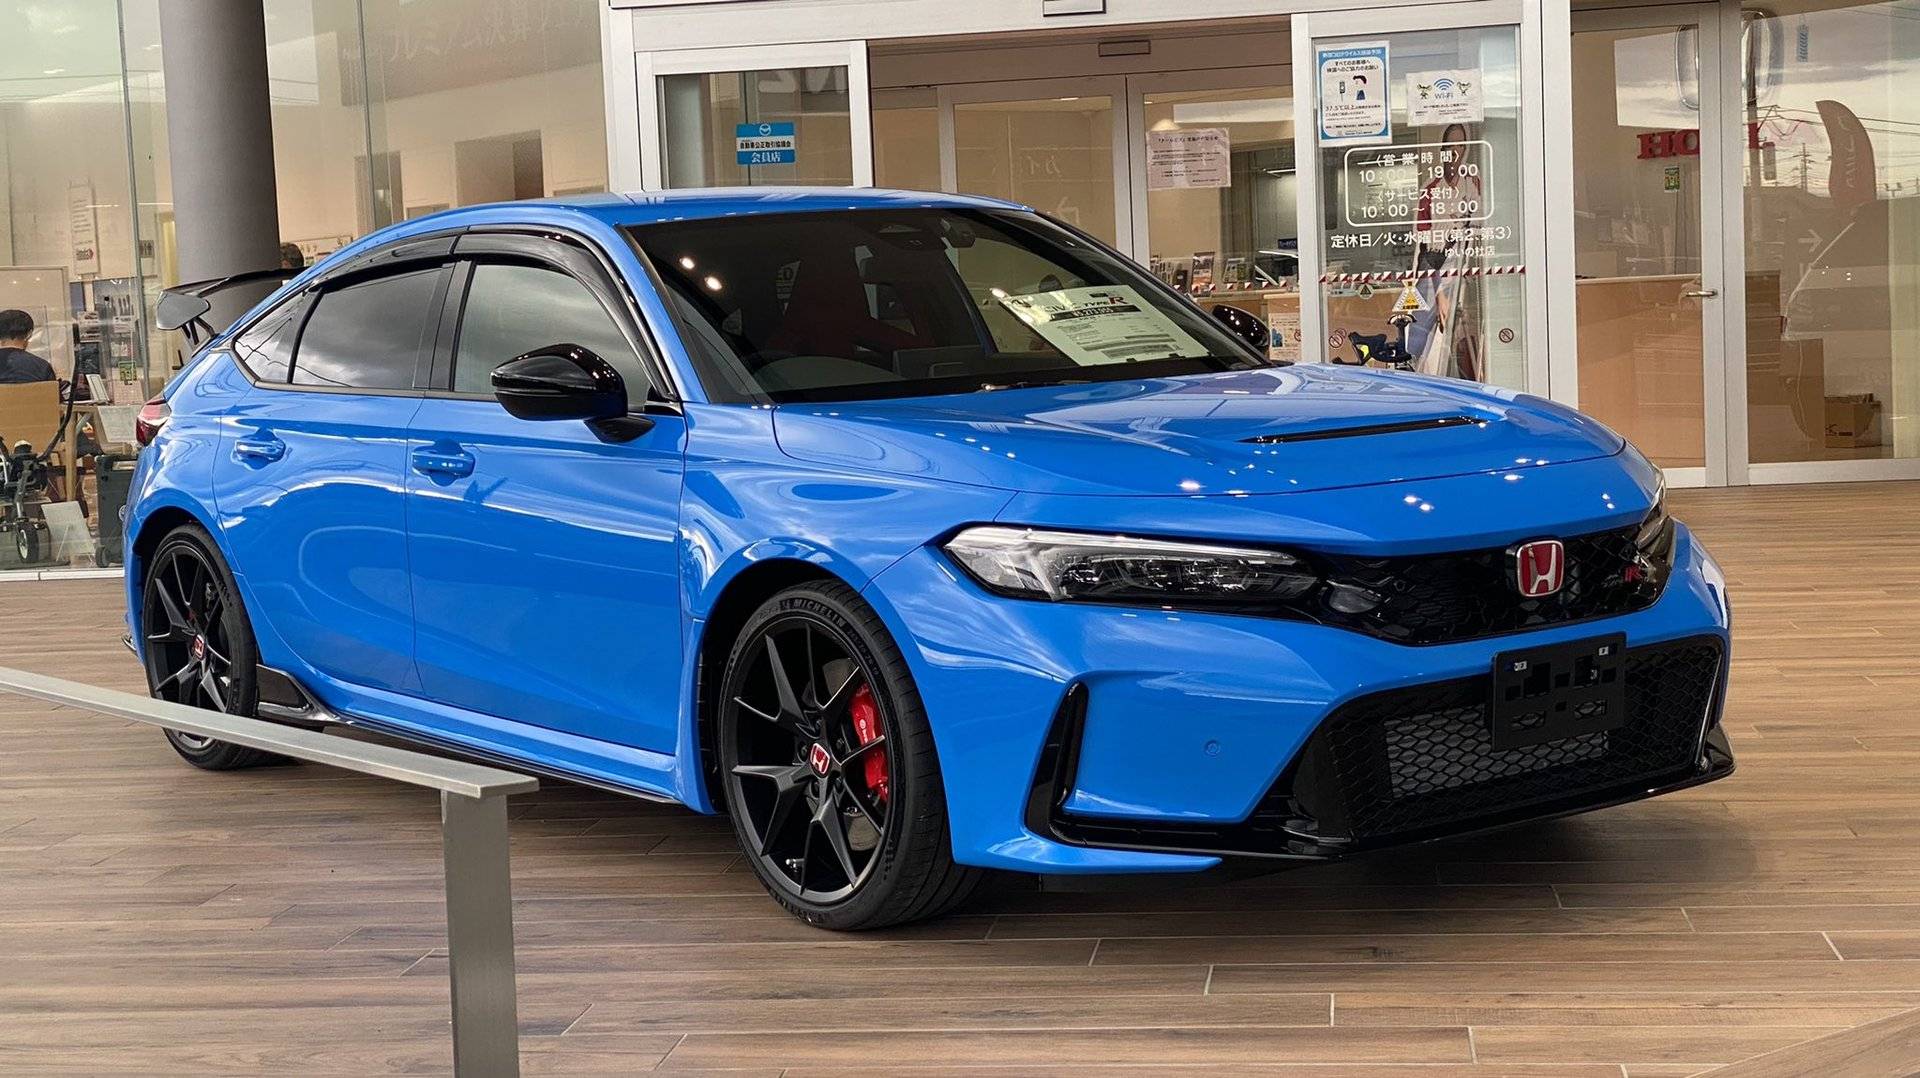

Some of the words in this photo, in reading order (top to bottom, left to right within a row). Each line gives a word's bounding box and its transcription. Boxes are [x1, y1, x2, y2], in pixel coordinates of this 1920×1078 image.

[751, 151, 781, 163] 会員店
[1045, 301, 1081, 313] CIVC
